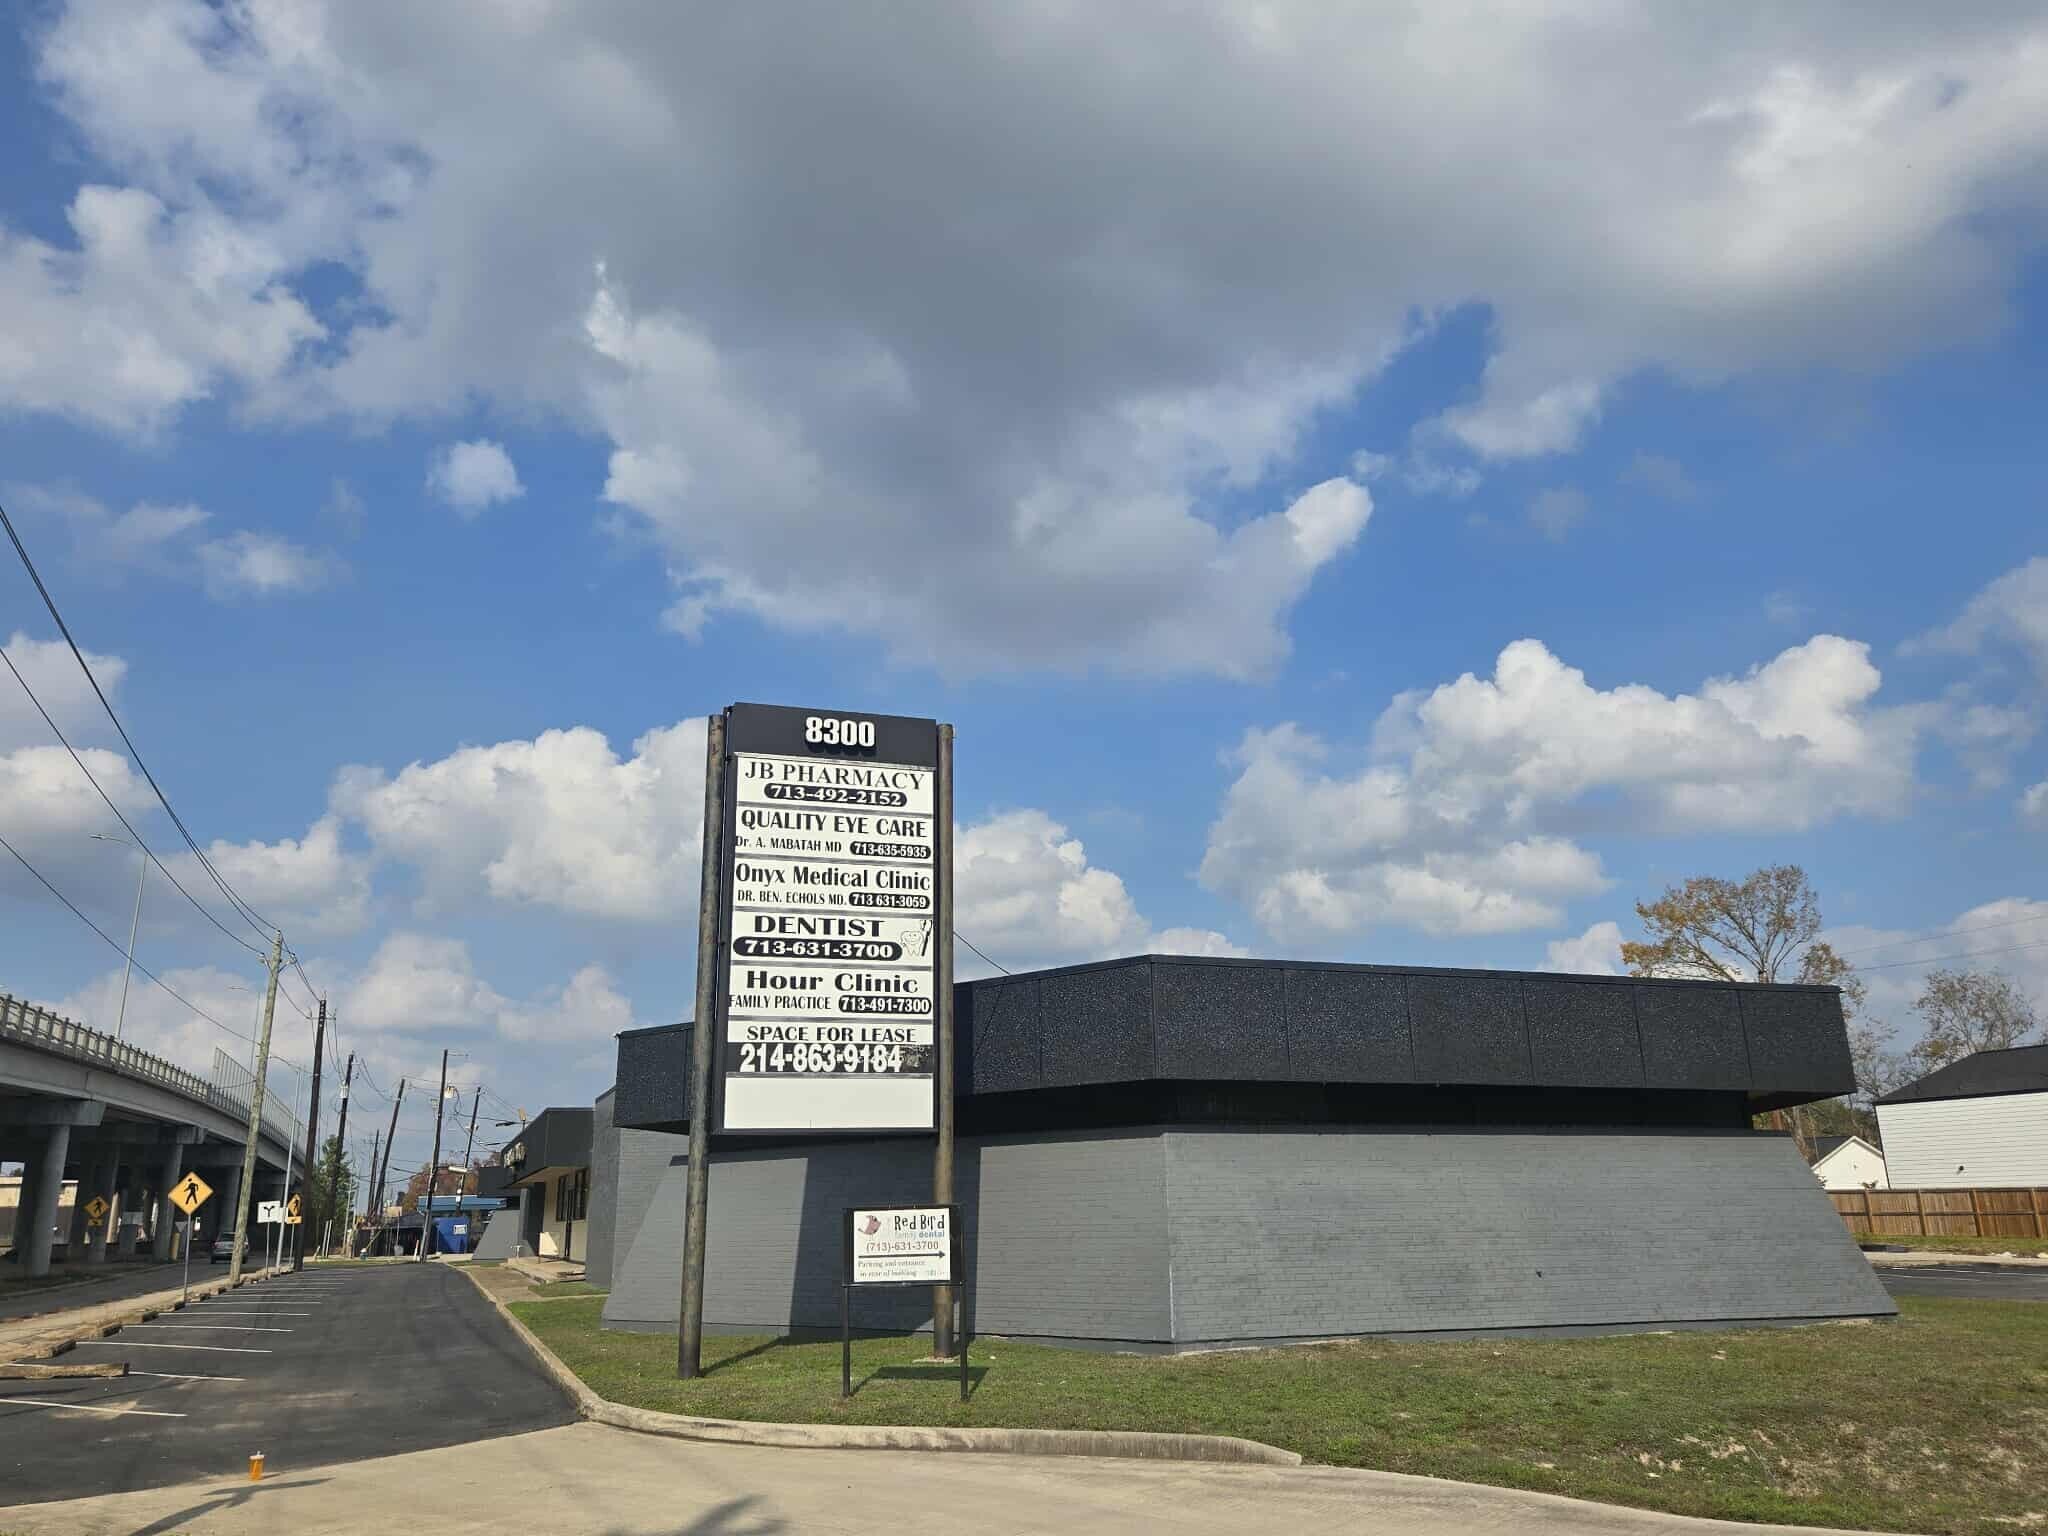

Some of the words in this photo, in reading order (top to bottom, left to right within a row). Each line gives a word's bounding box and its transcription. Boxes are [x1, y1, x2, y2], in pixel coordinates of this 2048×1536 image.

[805, 716, 876, 748] 8300
[745, 761, 774, 779] JB
[783, 763, 925, 790] PHARMACY
[770, 785, 902, 806] 713-492-2152
[741, 810, 827, 832] QUALITY
[834, 815, 869, 834] EYE
[876, 818, 928, 838] CARE
[736, 836, 751, 847] Dr.
[756, 836, 766, 848] A.
[770, 837, 821, 851] MABATAH
[825, 841, 842, 852] MD
[854, 843, 927, 856] 713-635-5935
[736, 863, 785, 887] Onyx
[793, 866, 868, 887] Medical
[876, 870, 930, 890] Clinic
[738, 889, 755, 902] DR.
[760, 890, 782, 903] BEN.
[786, 891, 825, 905] ECHOLS
[754, 915, 885, 937] DENTIST
[745, 940, 893, 958] 713-631-3700
[747, 971, 823, 990] Hour
[835, 973, 918, 993] Clinic
[729, 994, 770, 1008] FAMILY
[775, 995, 832, 1009] PRACTICE
[841, 997, 930, 1012] 713-491-7300
[747, 1026, 808, 1041] SPACE
[816, 1027, 853, 1041] FOR
[861, 1028, 917, 1042] LEASE
[740, 1043, 904, 1073] 214-863-9184
